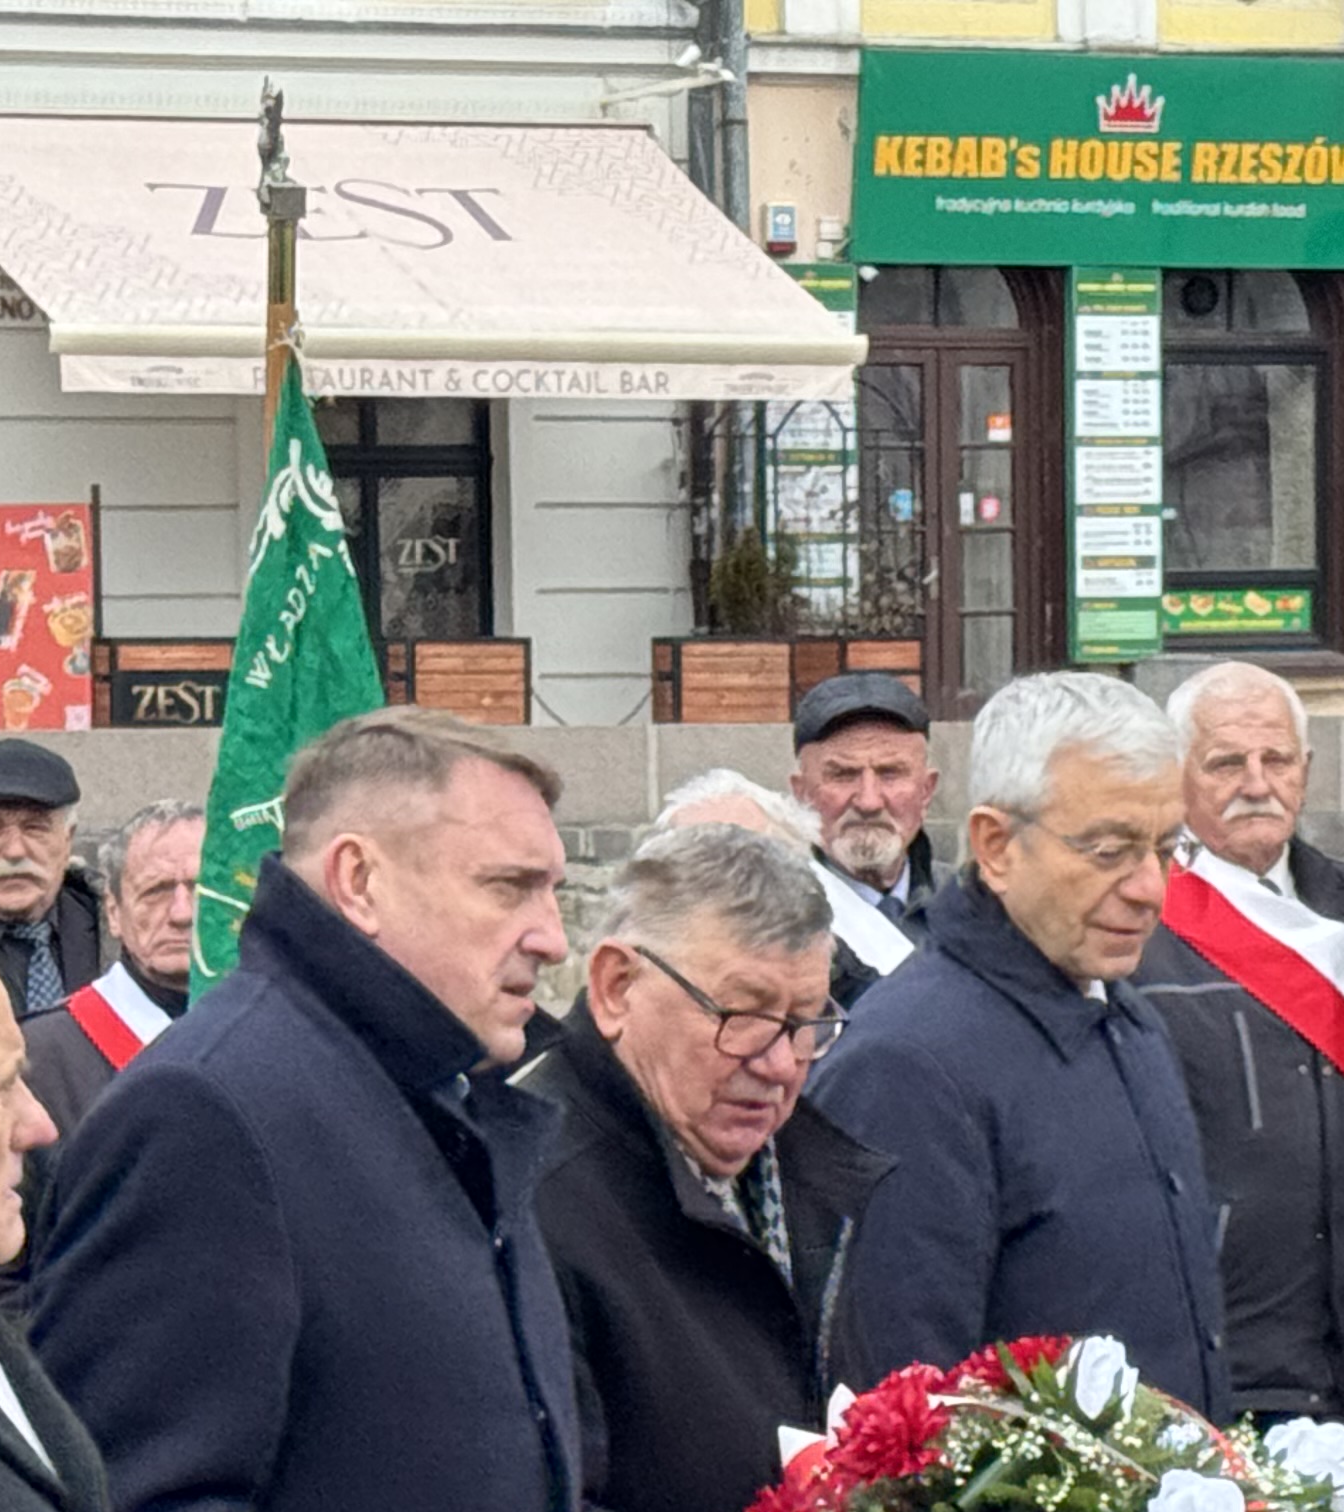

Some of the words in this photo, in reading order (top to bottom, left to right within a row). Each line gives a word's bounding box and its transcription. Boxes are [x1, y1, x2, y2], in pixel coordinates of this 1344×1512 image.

[874, 136, 1042, 179] KEBAB's
[1049, 138, 1182, 183] HOUSE
[144, 178, 514, 250] ZEST
[444, 369, 462, 393] &
[472, 369, 609, 394] COCKTAIL
[619, 370, 670, 395] BAR
[130, 680, 222, 725] ZEST
